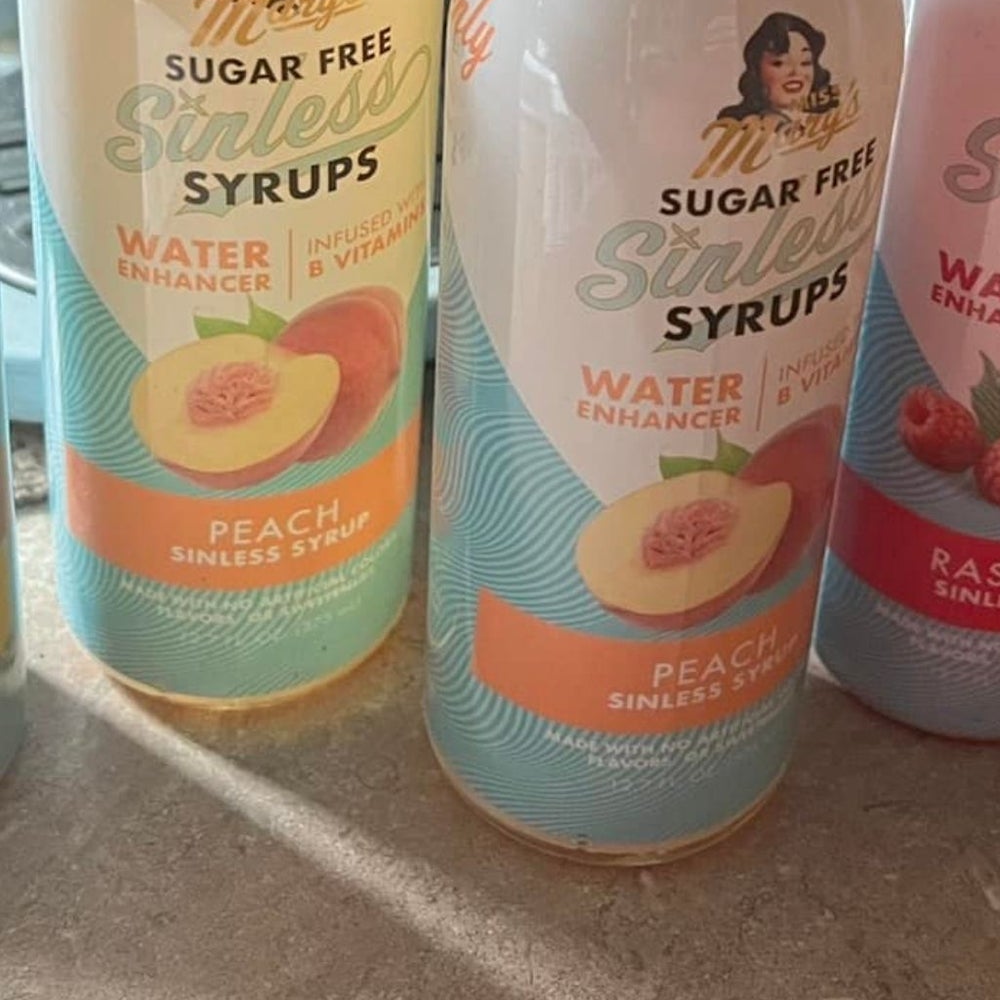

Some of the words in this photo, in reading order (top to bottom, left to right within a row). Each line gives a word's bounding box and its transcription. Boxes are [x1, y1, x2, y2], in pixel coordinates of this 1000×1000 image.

[165, 53, 304, 85] SUGAR
[319, 26, 393, 76] FREE
[104, 44, 432, 175] Sinless
[184, 145, 379, 206] SYRUPS
[660, 177, 801, 218] SUGAR
[815, 137, 877, 197] FREE
[116, 224, 271, 270] WATER
[308, 208, 394, 256] INFUSED
[575, 183, 874, 312] Sinless
[117, 260, 272, 293] ENHANCER
[308, 259, 324, 279] B
[664, 261, 849, 341] SYRUPS
[580, 364, 744, 407] WATER
[777, 385, 791, 406] B
[576, 400, 742, 431] ENHANCER
[170, 545, 280, 567] SINLESS
[292, 511, 371, 557] SYRUP
[209, 499, 340, 545] PEACH
[607, 682, 722, 710] SINLESS
[731, 633, 799, 690] SYRUP
[651, 627, 777, 688] PEACH
